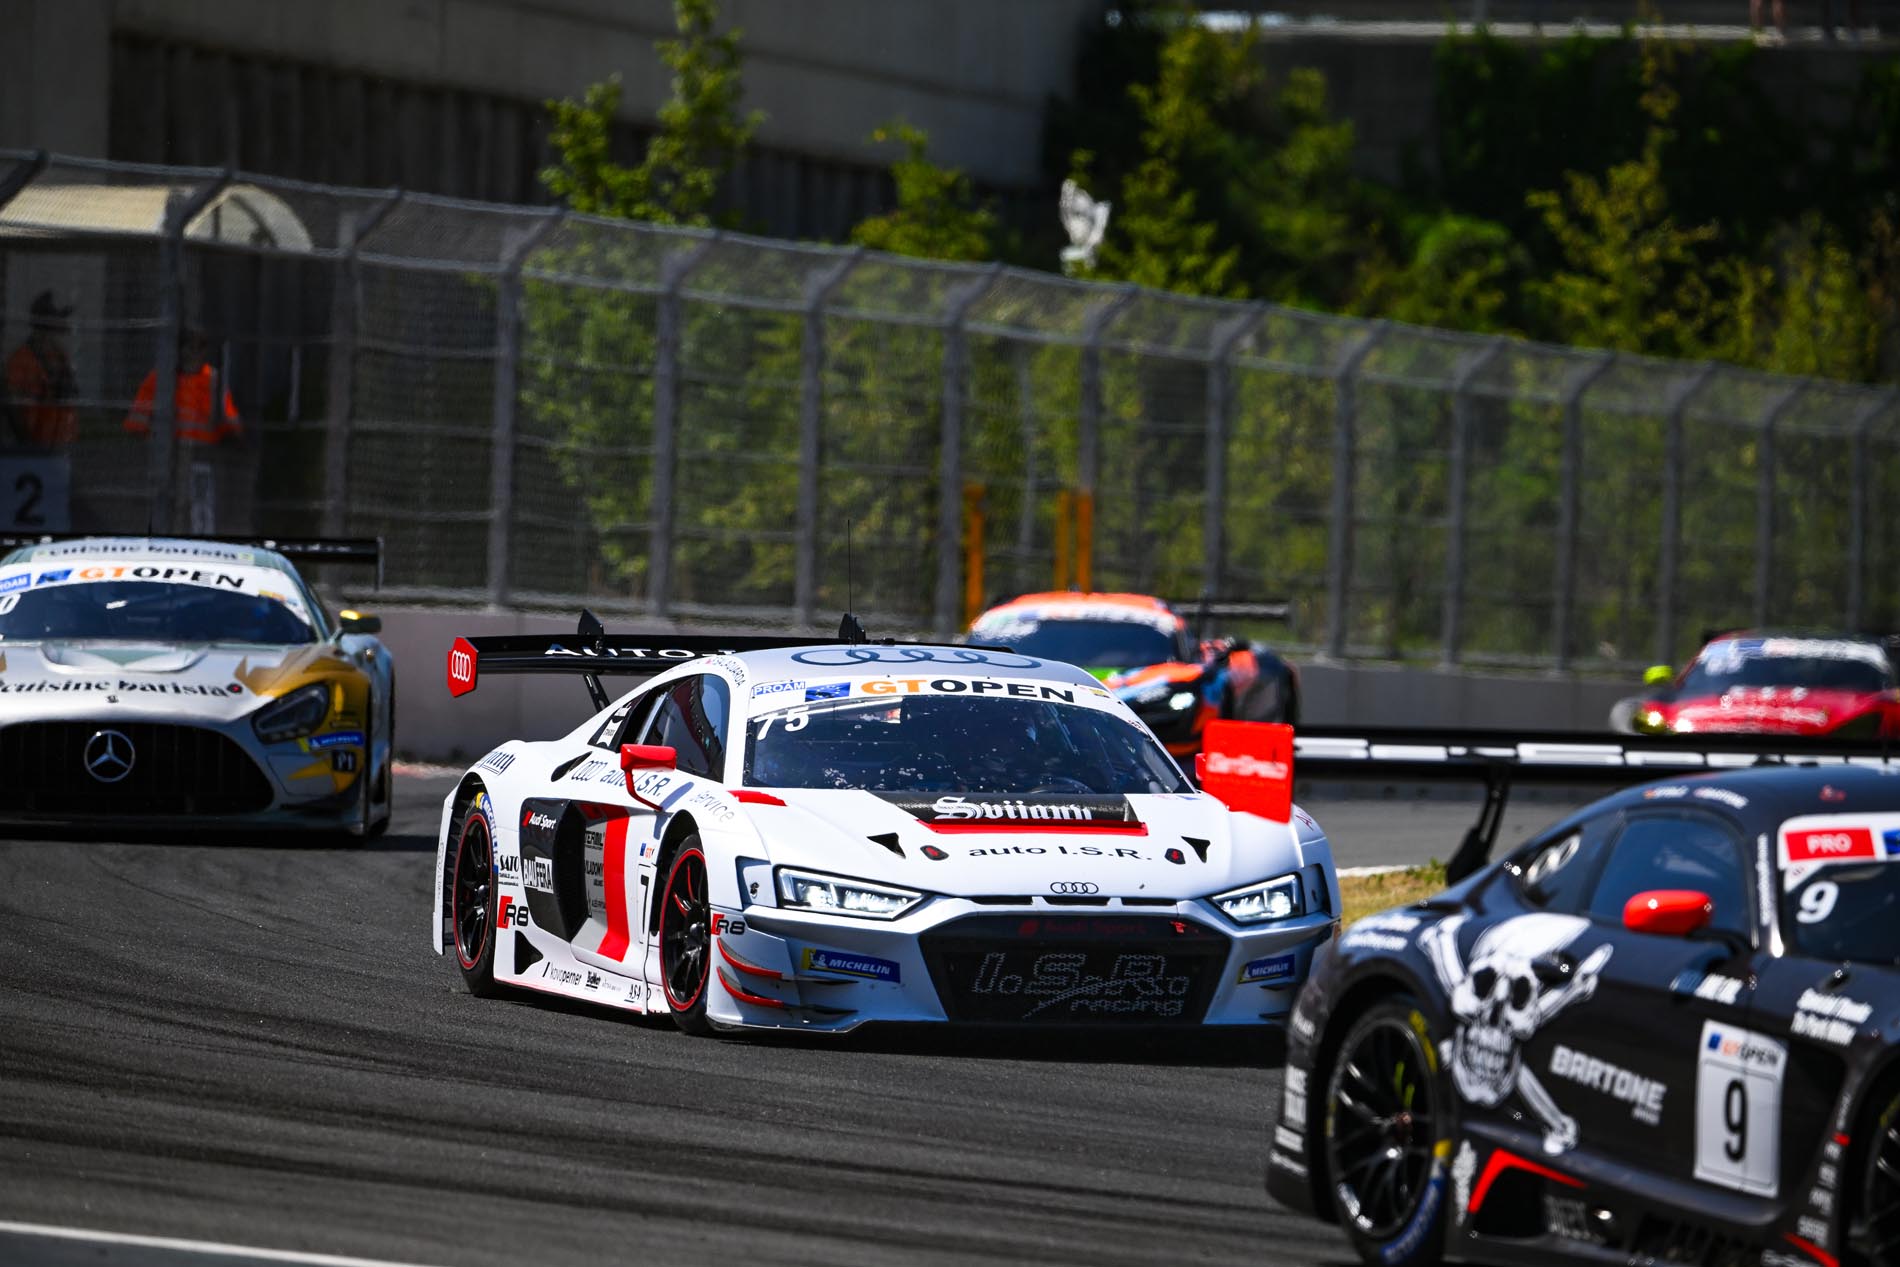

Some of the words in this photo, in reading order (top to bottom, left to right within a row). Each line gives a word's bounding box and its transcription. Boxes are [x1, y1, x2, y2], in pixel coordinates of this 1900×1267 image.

[15, 471, 46, 525] 2
[754, 682, 806, 696] PROAM
[753, 705, 809, 741] 75
[529, 812, 543, 826] Audi
[541, 814, 557, 830] Sport
[969, 845, 1047, 857] auto
[1805, 832, 1853, 855] PRO
[1796, 881, 1840, 923] 9
[503, 904, 529, 927] R8
[716, 918, 746, 936] R8
[828, 959, 891, 975] MICHELIN
[1548, 1045, 1667, 1111] BARTONE
[1724, 1077, 1748, 1163] 9
